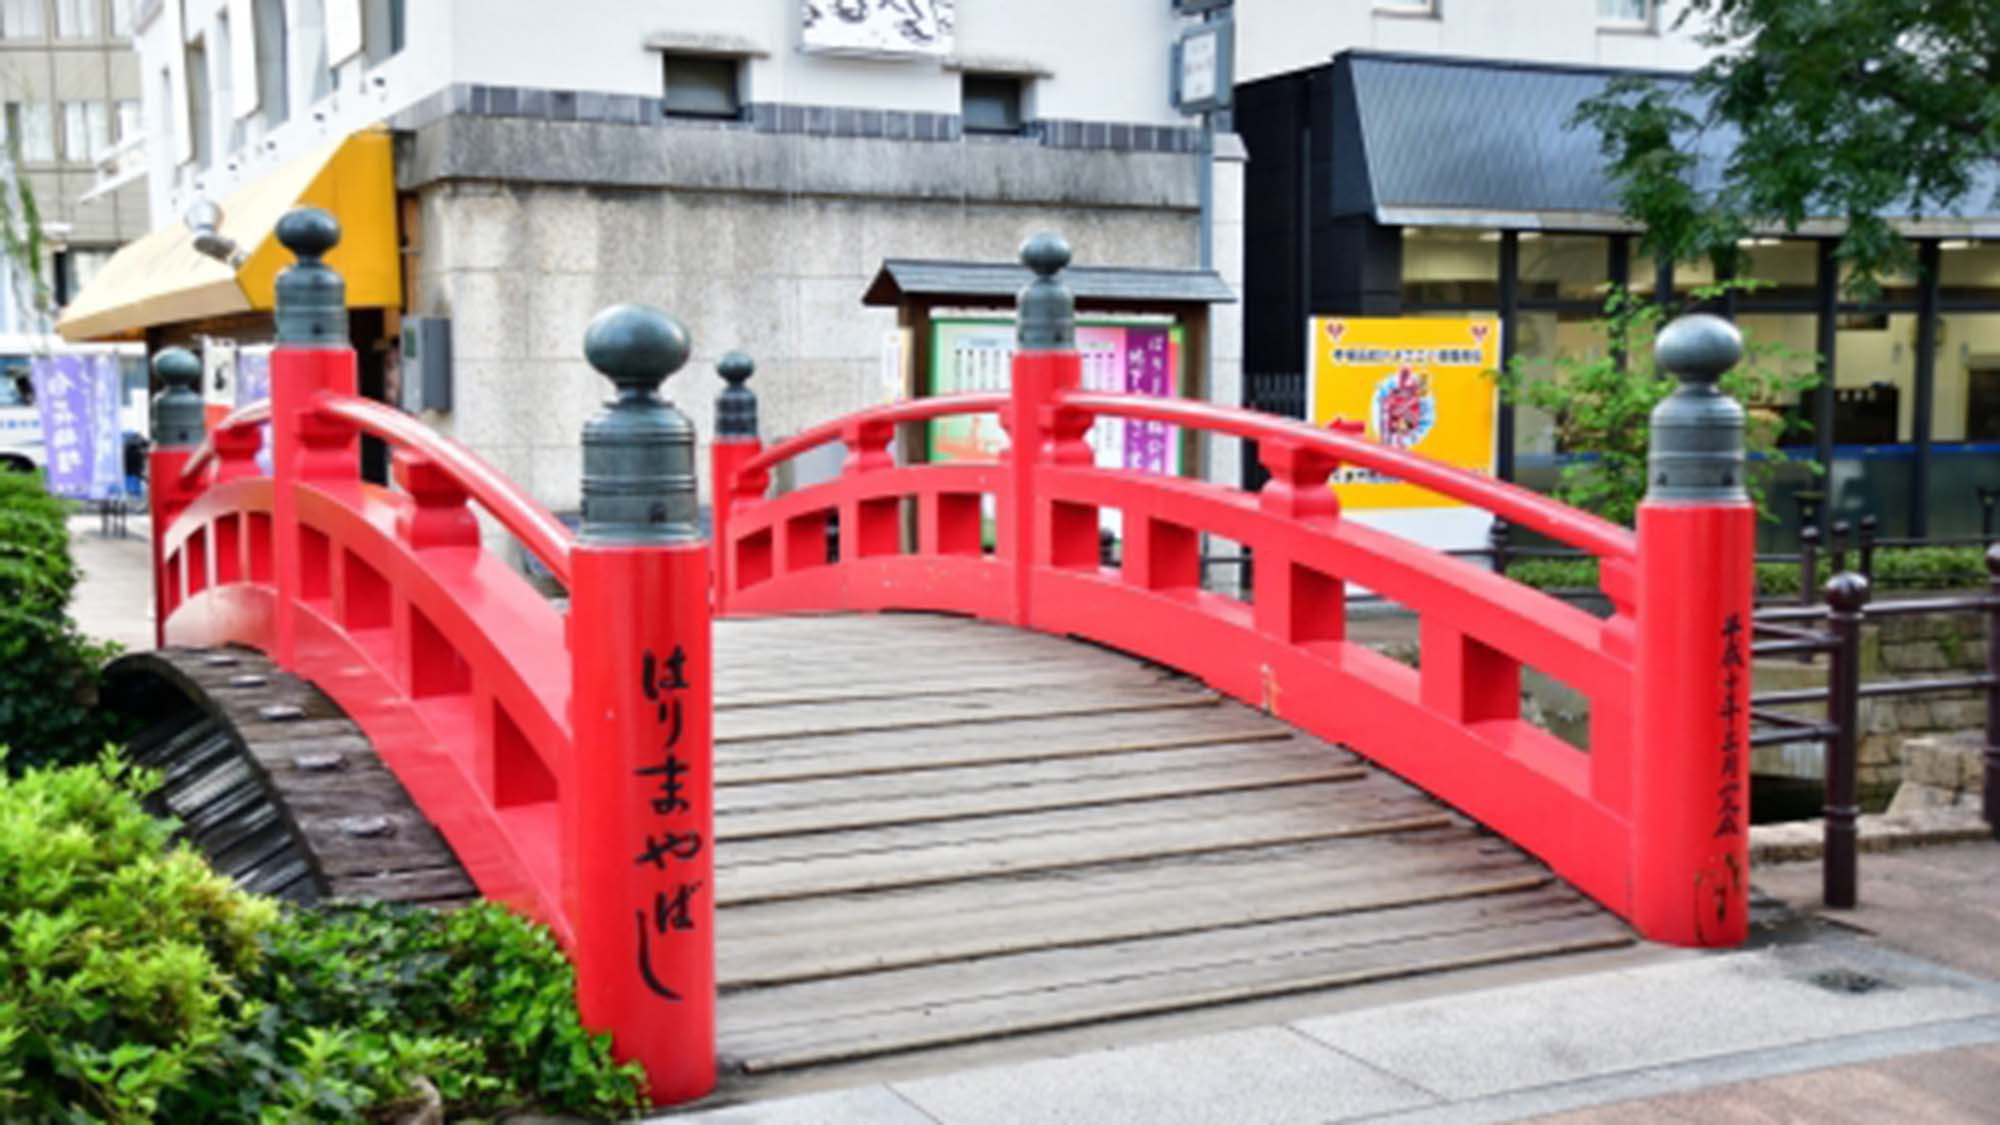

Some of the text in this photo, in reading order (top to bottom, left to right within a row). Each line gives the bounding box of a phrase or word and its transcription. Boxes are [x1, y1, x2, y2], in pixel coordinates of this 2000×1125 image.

[633, 645, 702, 1001] はりまやばし
